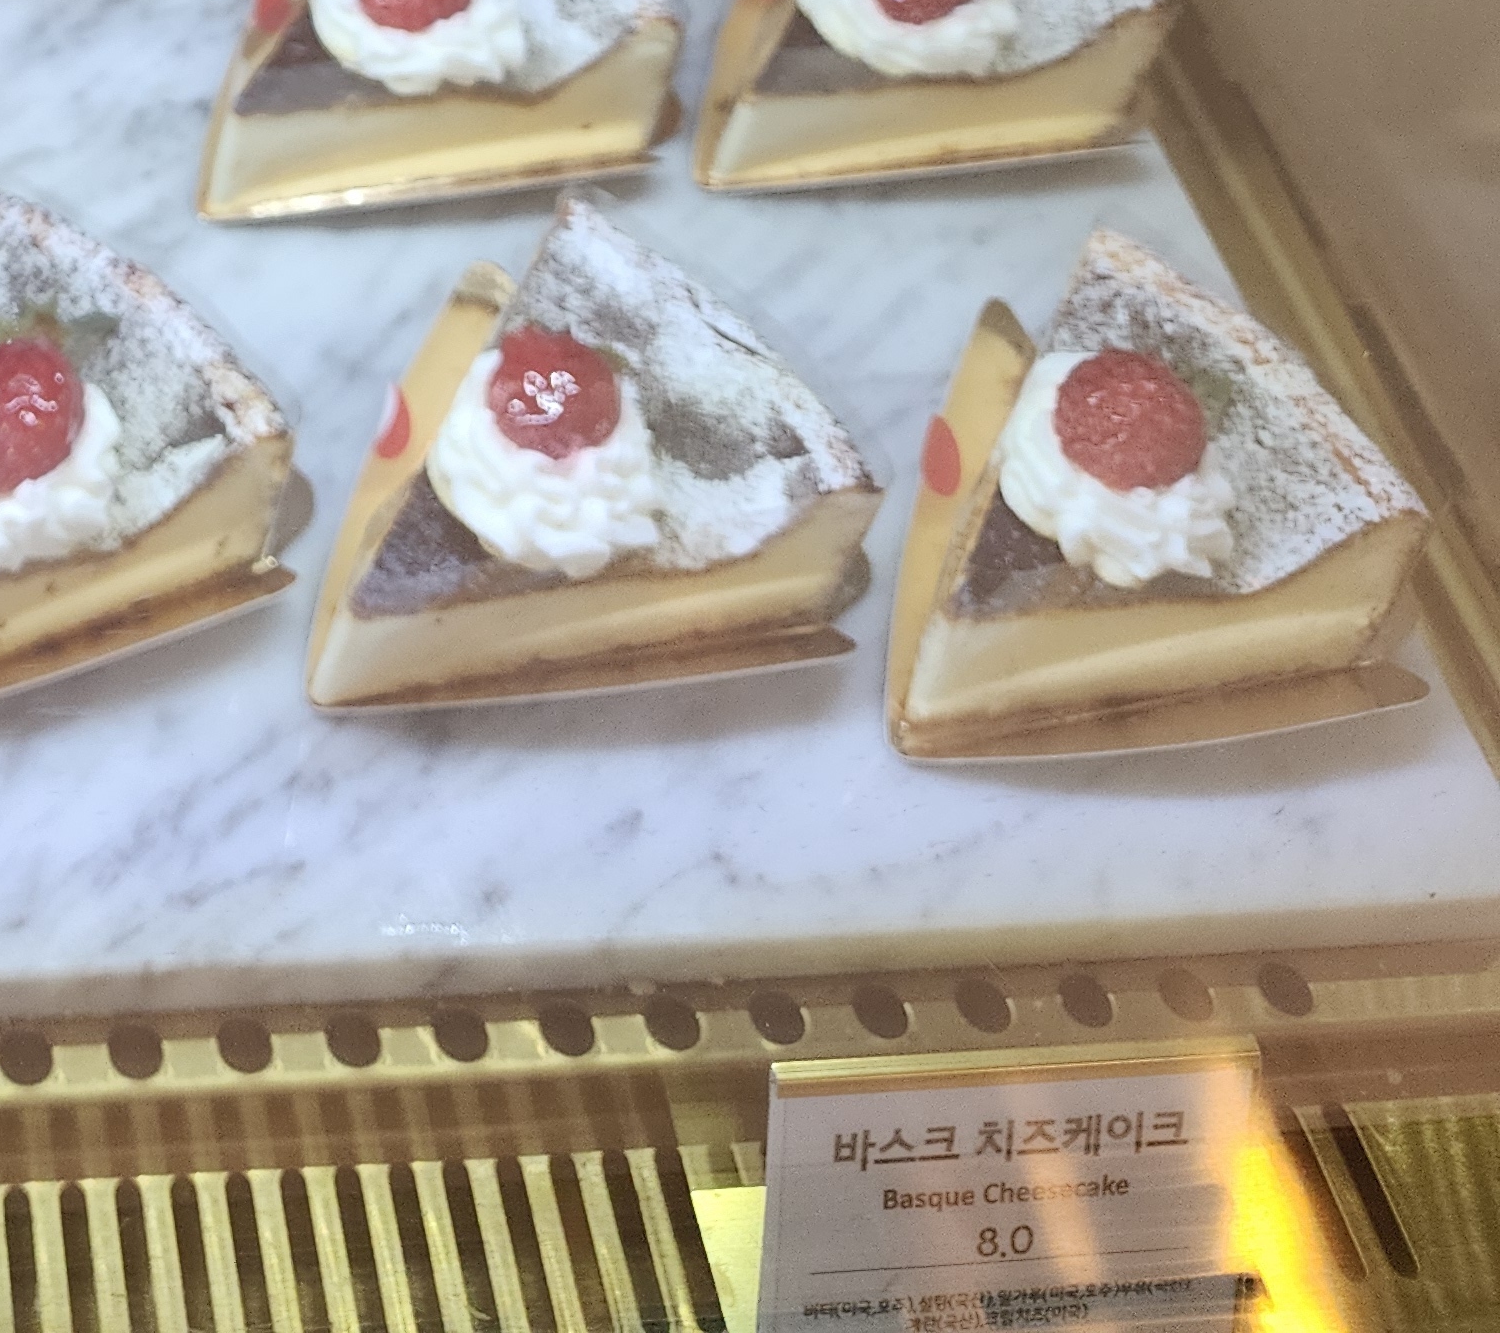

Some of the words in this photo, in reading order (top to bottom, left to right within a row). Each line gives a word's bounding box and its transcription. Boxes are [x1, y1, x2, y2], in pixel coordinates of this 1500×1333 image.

[833, 1125, 961, 1172] 바스크
[974, 1110, 1190, 1162] 치즈케이크
[882, 1189, 976, 1213] Basque
[982, 1174, 1131, 1205] Cheesecake
[975, 1224, 1035, 1259] 8.0
